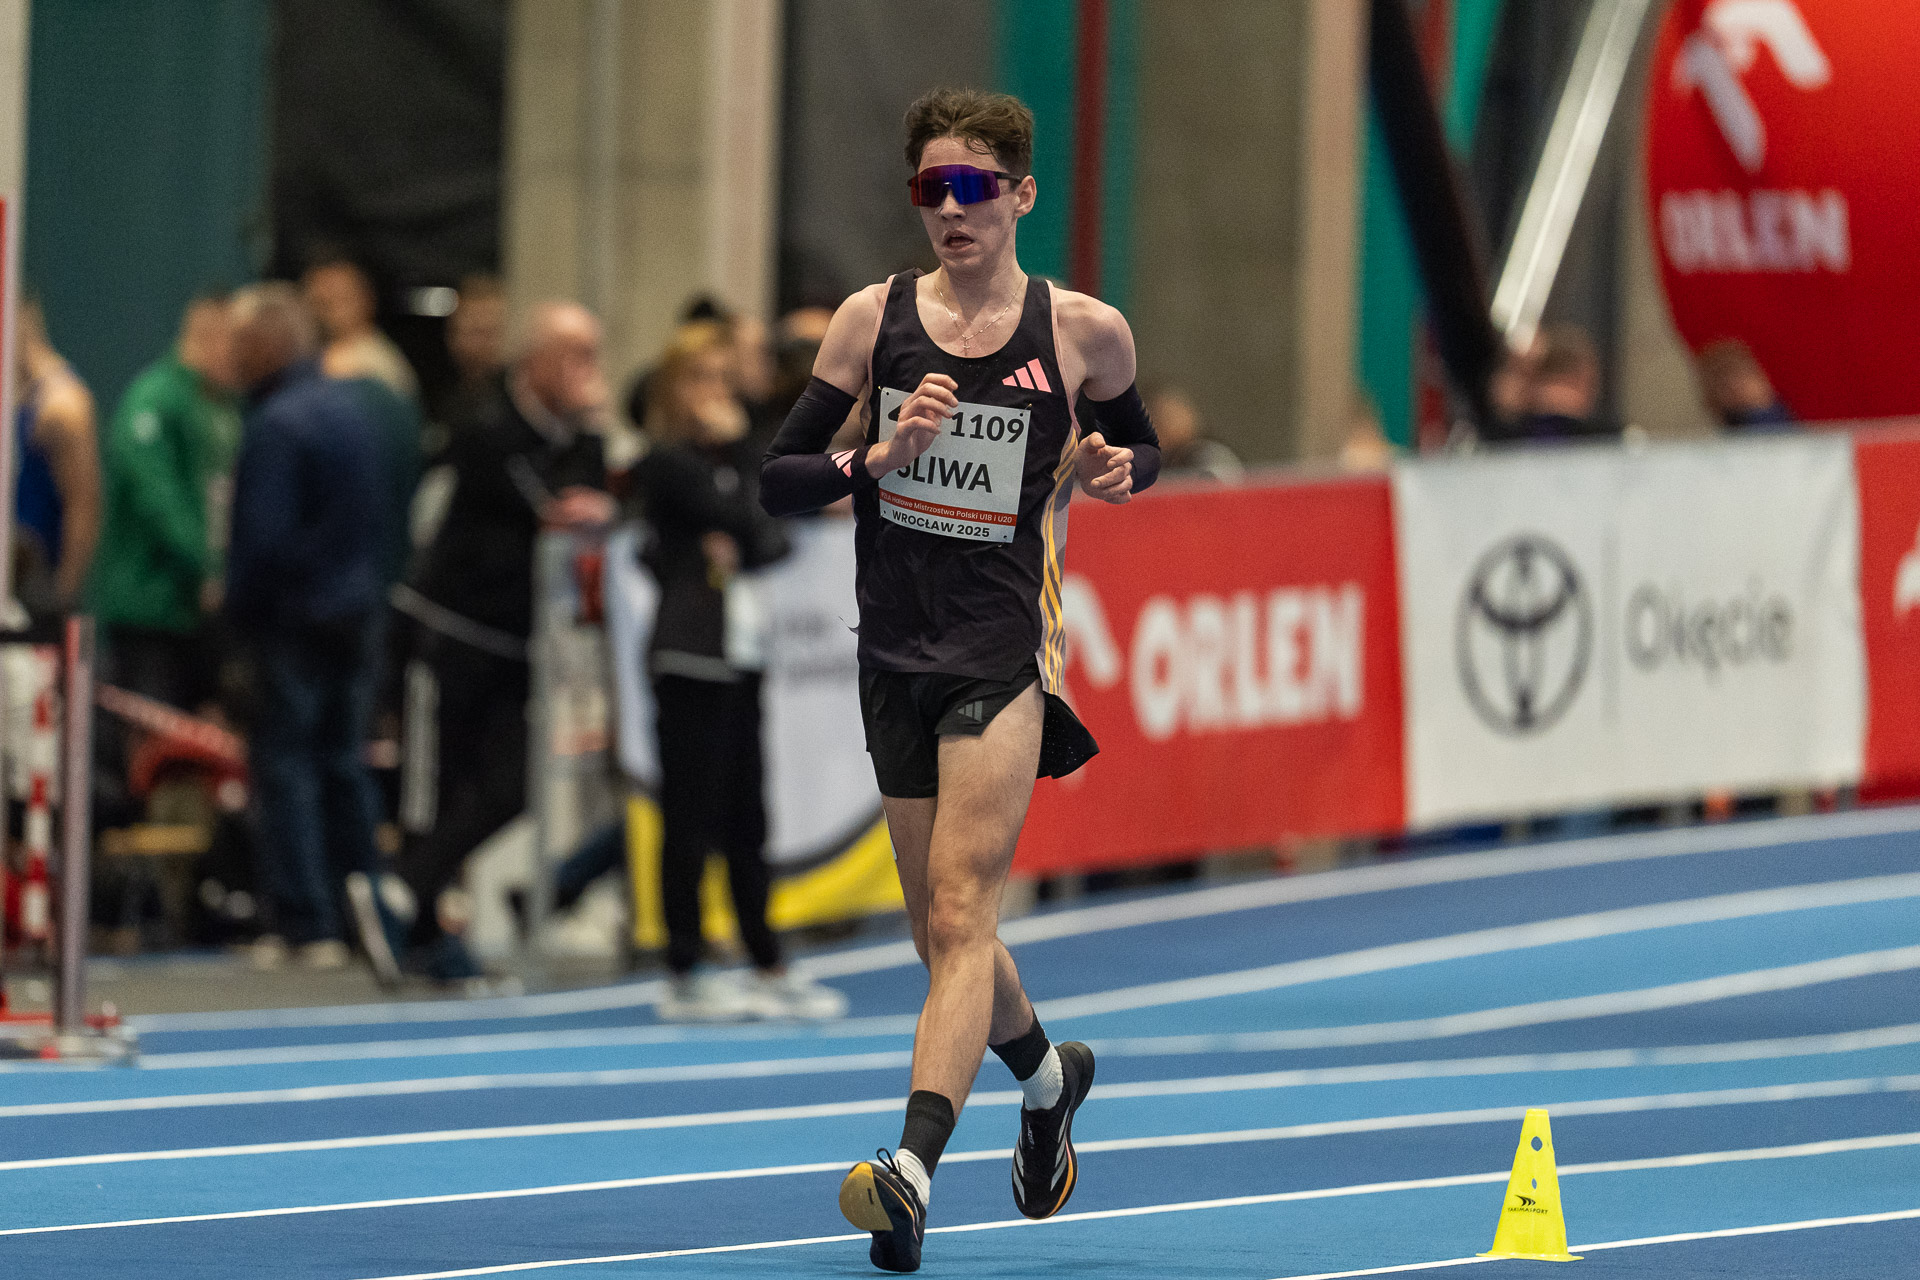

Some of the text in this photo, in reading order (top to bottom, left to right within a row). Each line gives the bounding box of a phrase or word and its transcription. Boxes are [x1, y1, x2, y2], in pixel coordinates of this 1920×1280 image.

[1660, 188, 1850, 273] ORLEN
[950, 411, 1025, 443] 1109
[892, 510, 990, 537] WROCŁAW 2025
[913, 502, 955, 516] Mistrzostwa
[956, 510, 979, 520] Polski
[979, 513, 993, 521] U18
[1131, 580, 1365, 740] ORLEN
